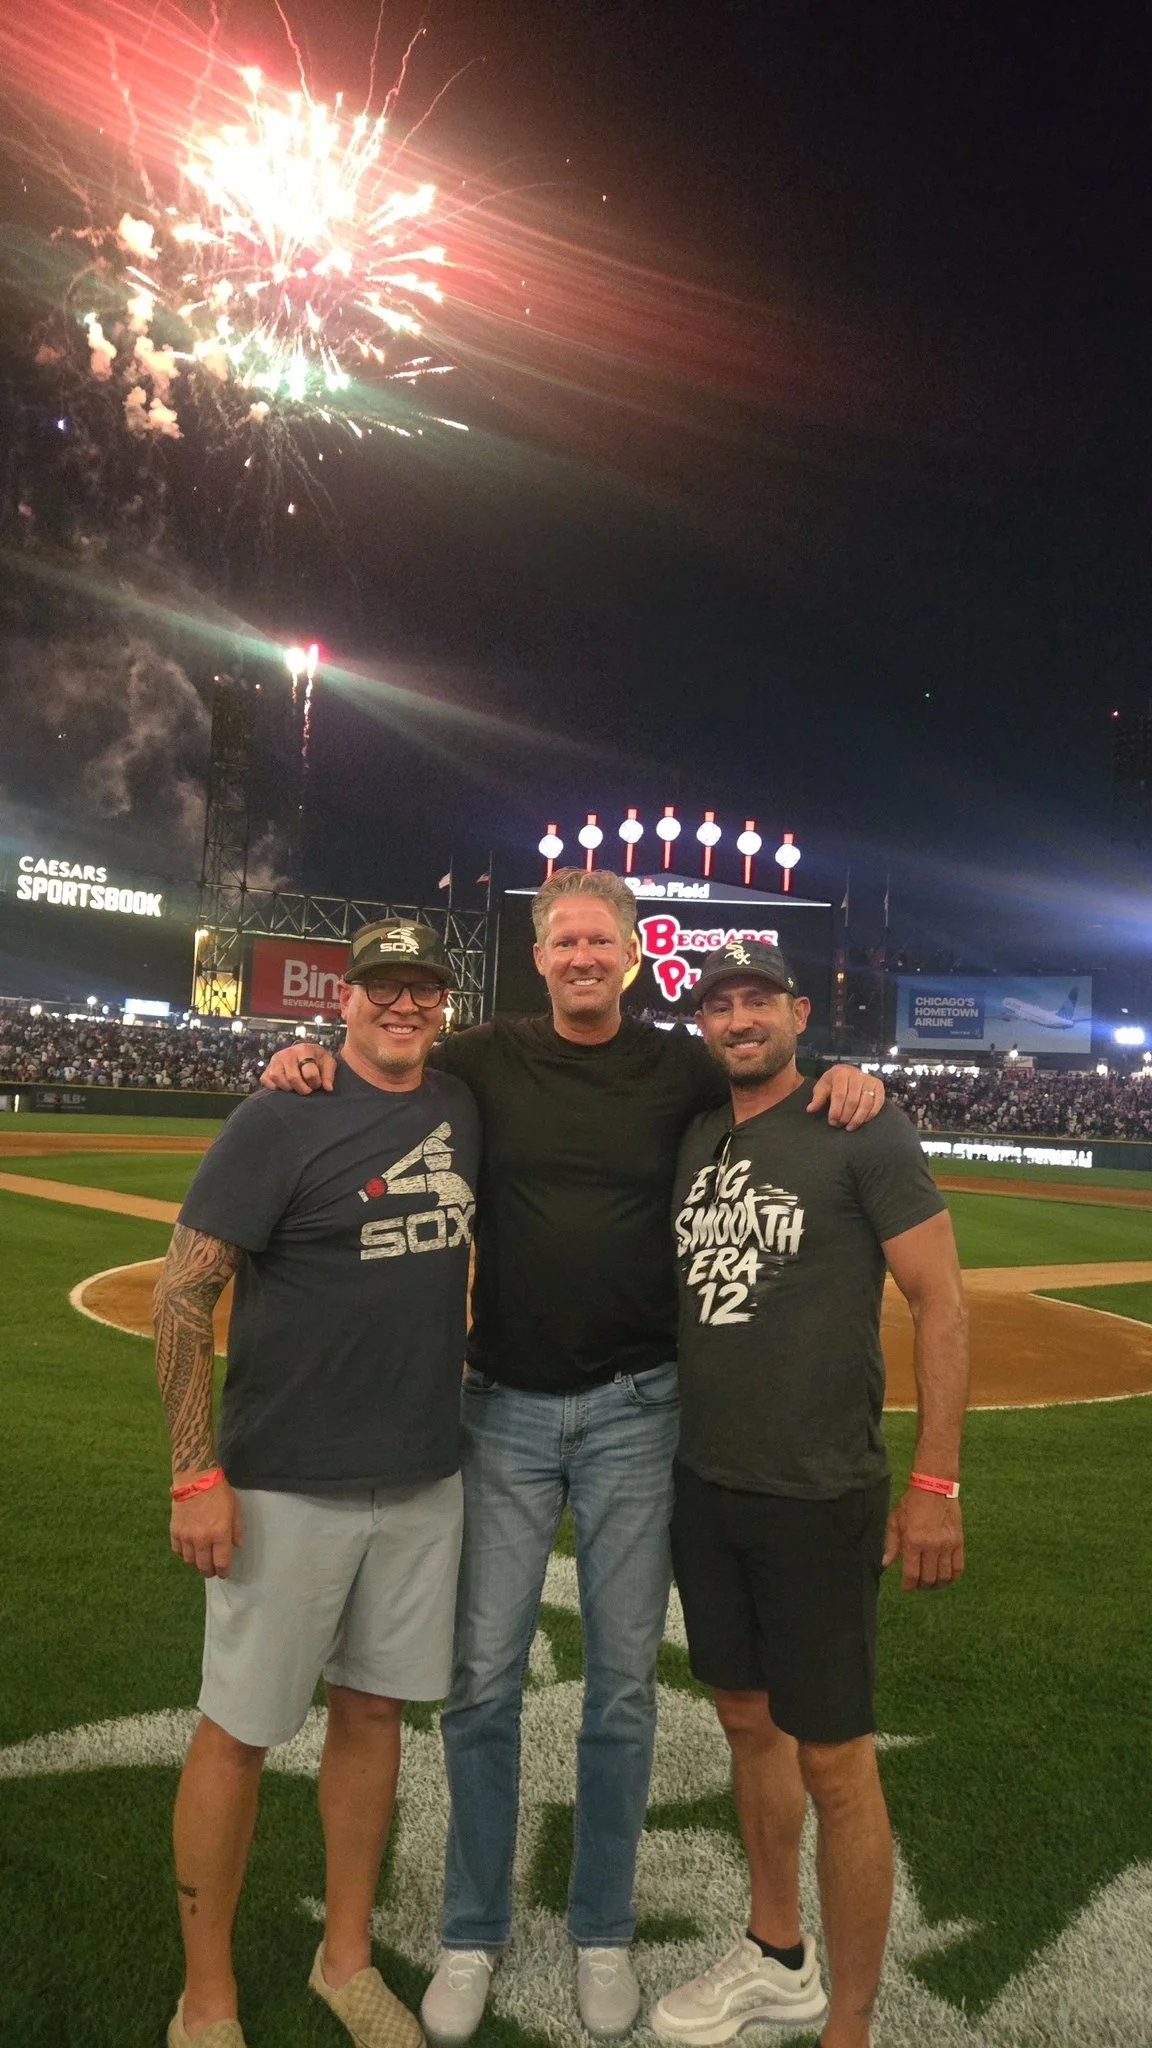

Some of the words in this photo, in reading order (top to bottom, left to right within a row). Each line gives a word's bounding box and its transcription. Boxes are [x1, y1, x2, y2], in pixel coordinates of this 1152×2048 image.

[19, 856, 107, 882] CAESARS
[17, 875, 162, 917] SPORTSBOOK
[667, 882, 710, 899] Field
[380, 942, 420, 955] SOX
[283, 999, 325, 1009] BEVERAGE
[915, 997, 975, 1007] CHICAGO'S
[914, 1018, 954, 1027] AIRLINE
[915, 1008, 978, 1018] HOMETOWN
[684, 1160, 751, 1204] BG
[360, 1202, 476, 1260] SOX
[687, 1247, 761, 1286] ERA
[697, 1282, 753, 1326] 12
